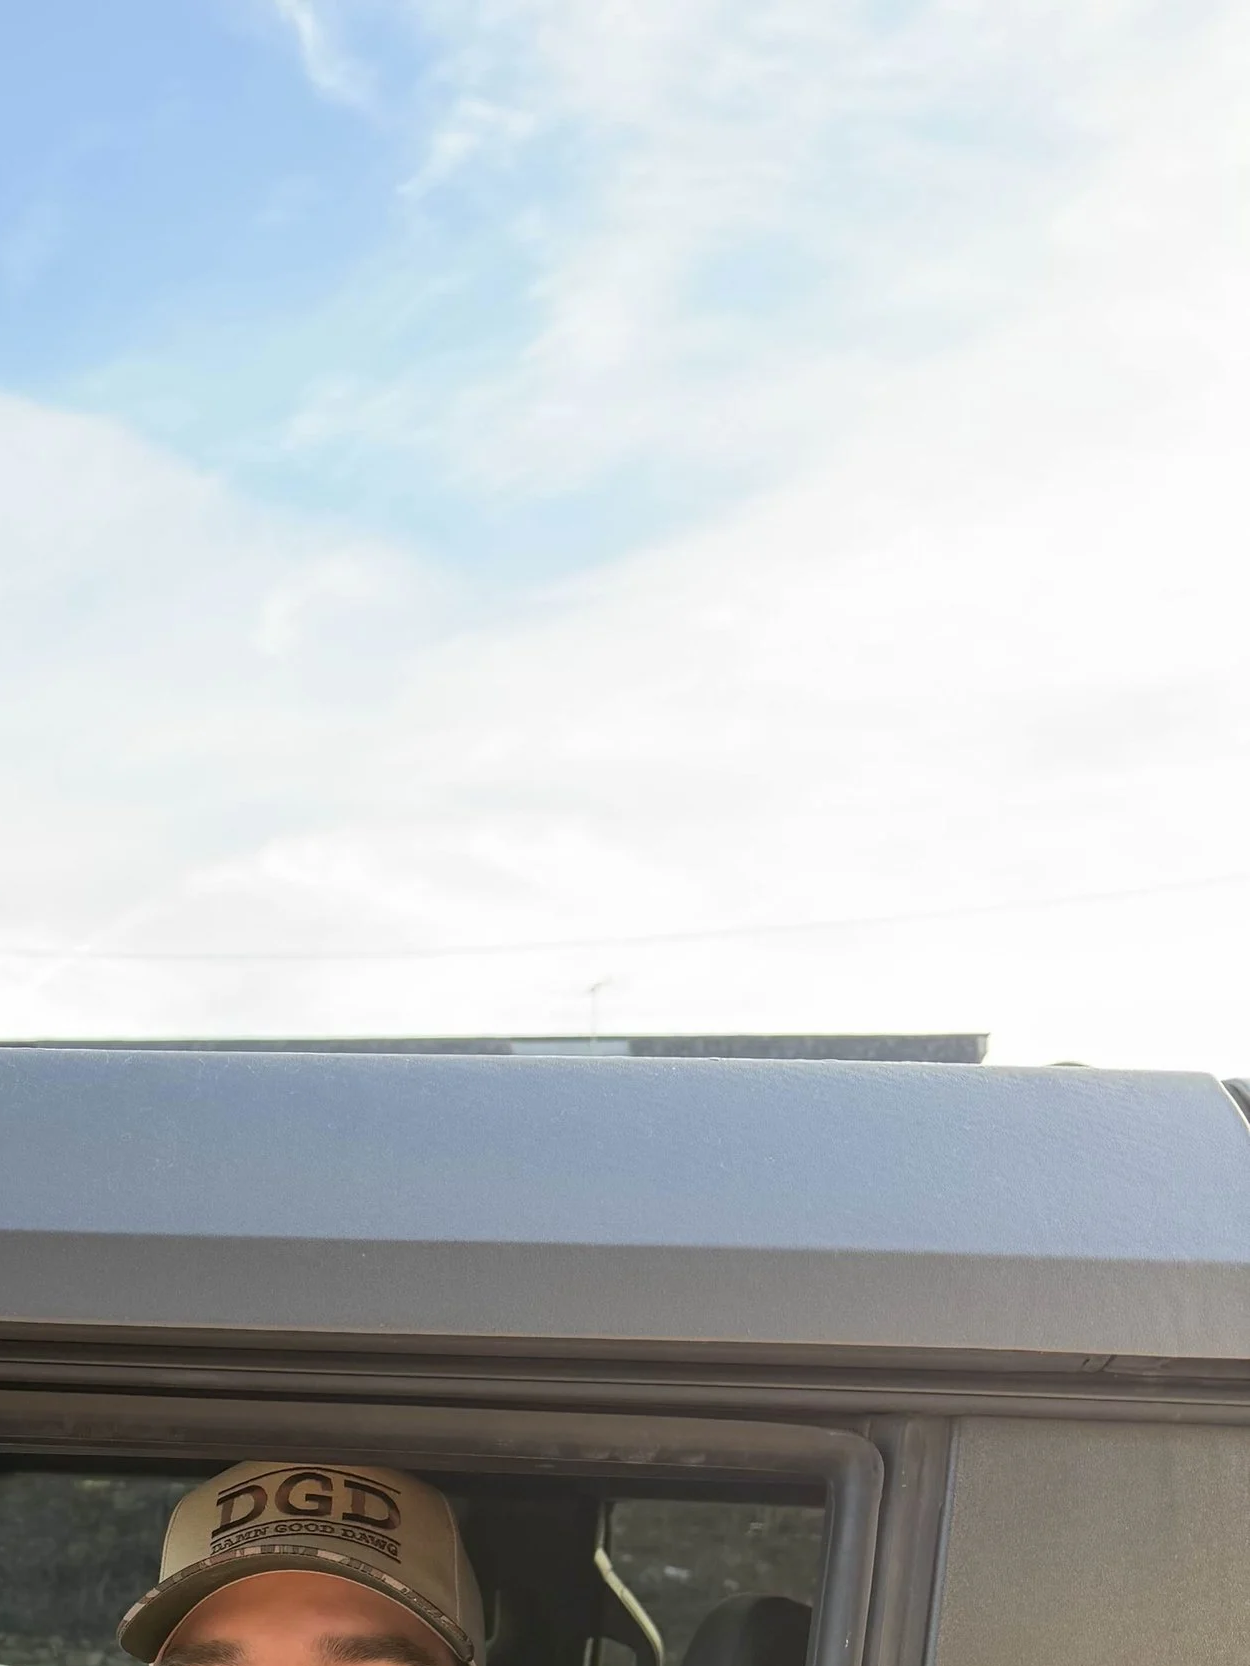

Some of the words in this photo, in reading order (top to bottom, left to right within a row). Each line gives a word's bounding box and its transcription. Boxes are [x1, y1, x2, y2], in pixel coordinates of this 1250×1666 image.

[212, 1472, 401, 1538] DGD
[274, 1522, 334, 1535] GOOD
[341, 1529, 400, 1557] DAWG
